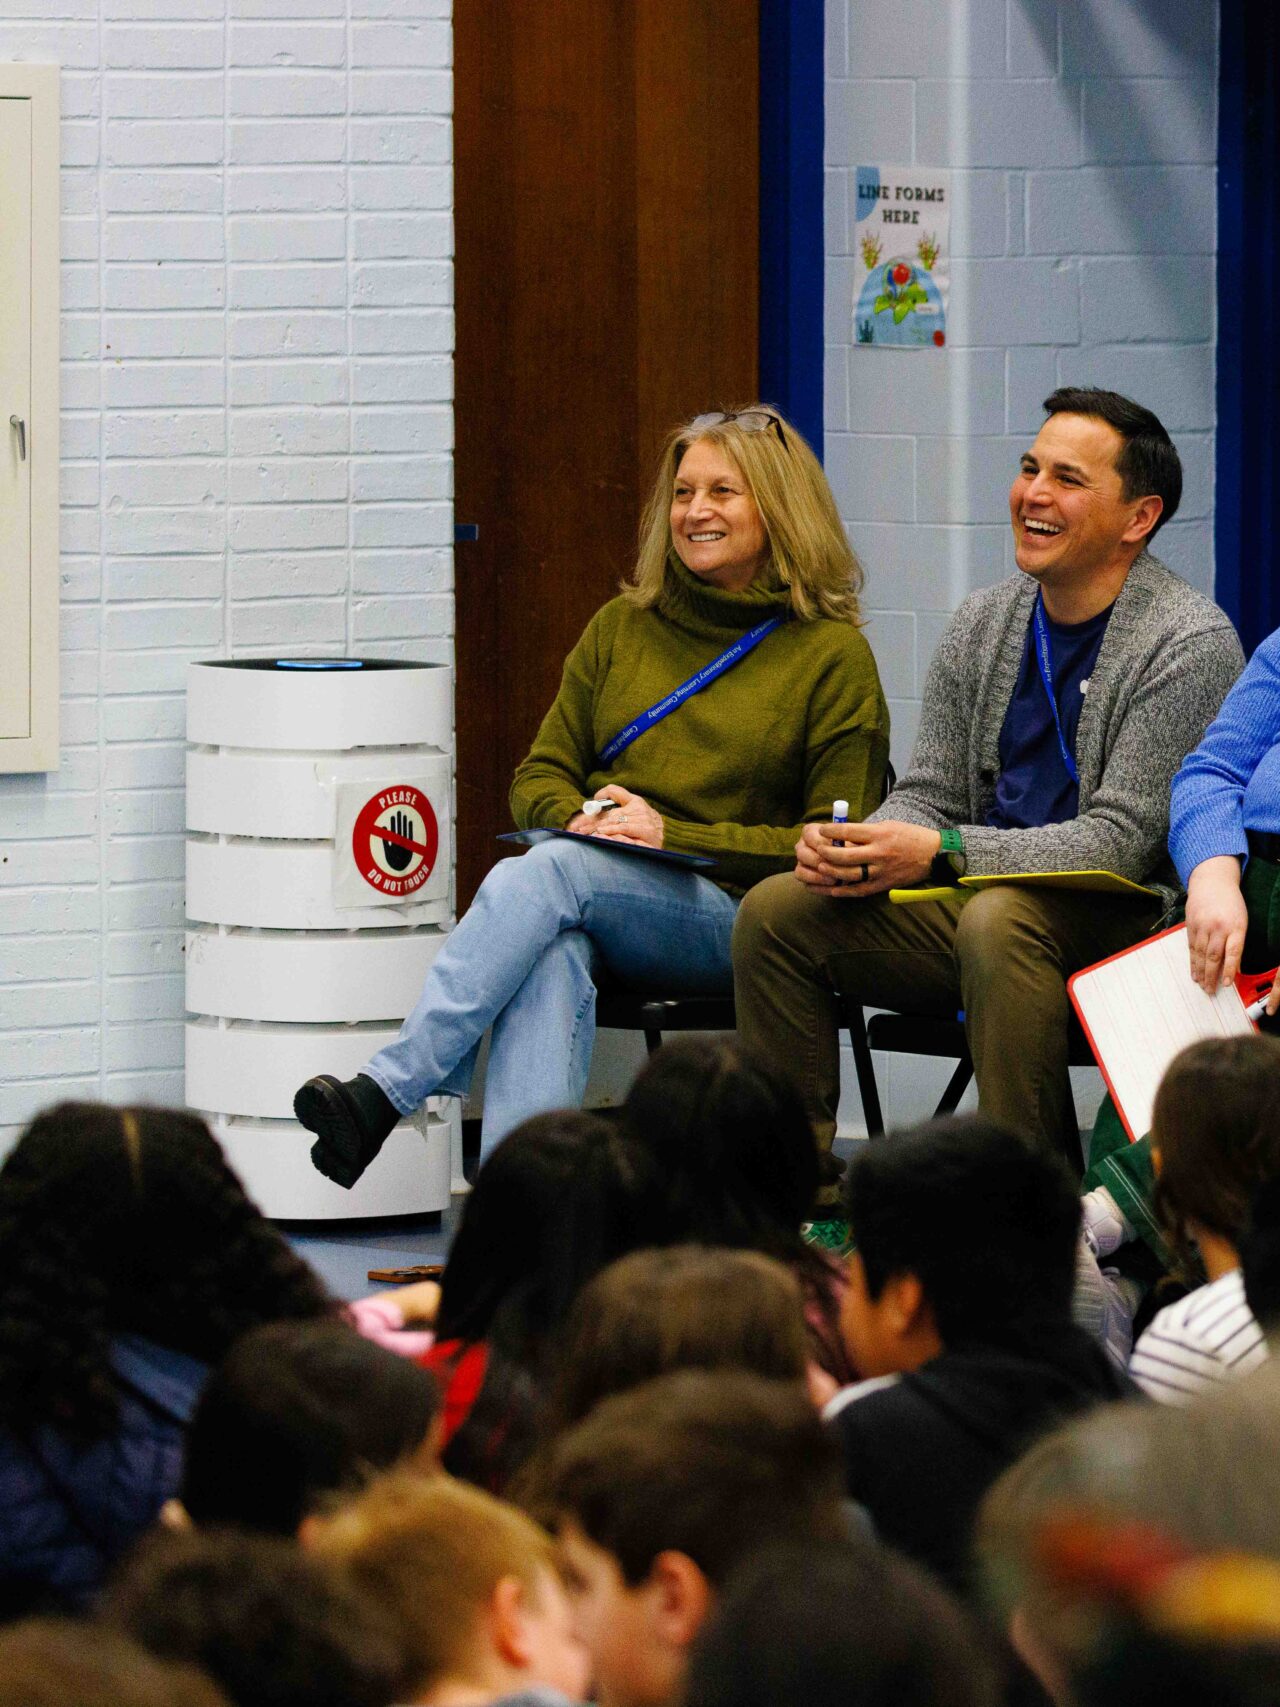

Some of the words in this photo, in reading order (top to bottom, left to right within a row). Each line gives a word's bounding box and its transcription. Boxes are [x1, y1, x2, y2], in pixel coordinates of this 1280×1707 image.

[858, 184, 889, 200] LINE
[895, 187, 945, 201] FORMS
[882, 209, 920, 224] HERE
[378, 790, 418, 809] PLEASE
[367, 868, 382, 883] DO
[382, 879, 402, 892] NOT
[404, 864, 430, 891] TOUCH
